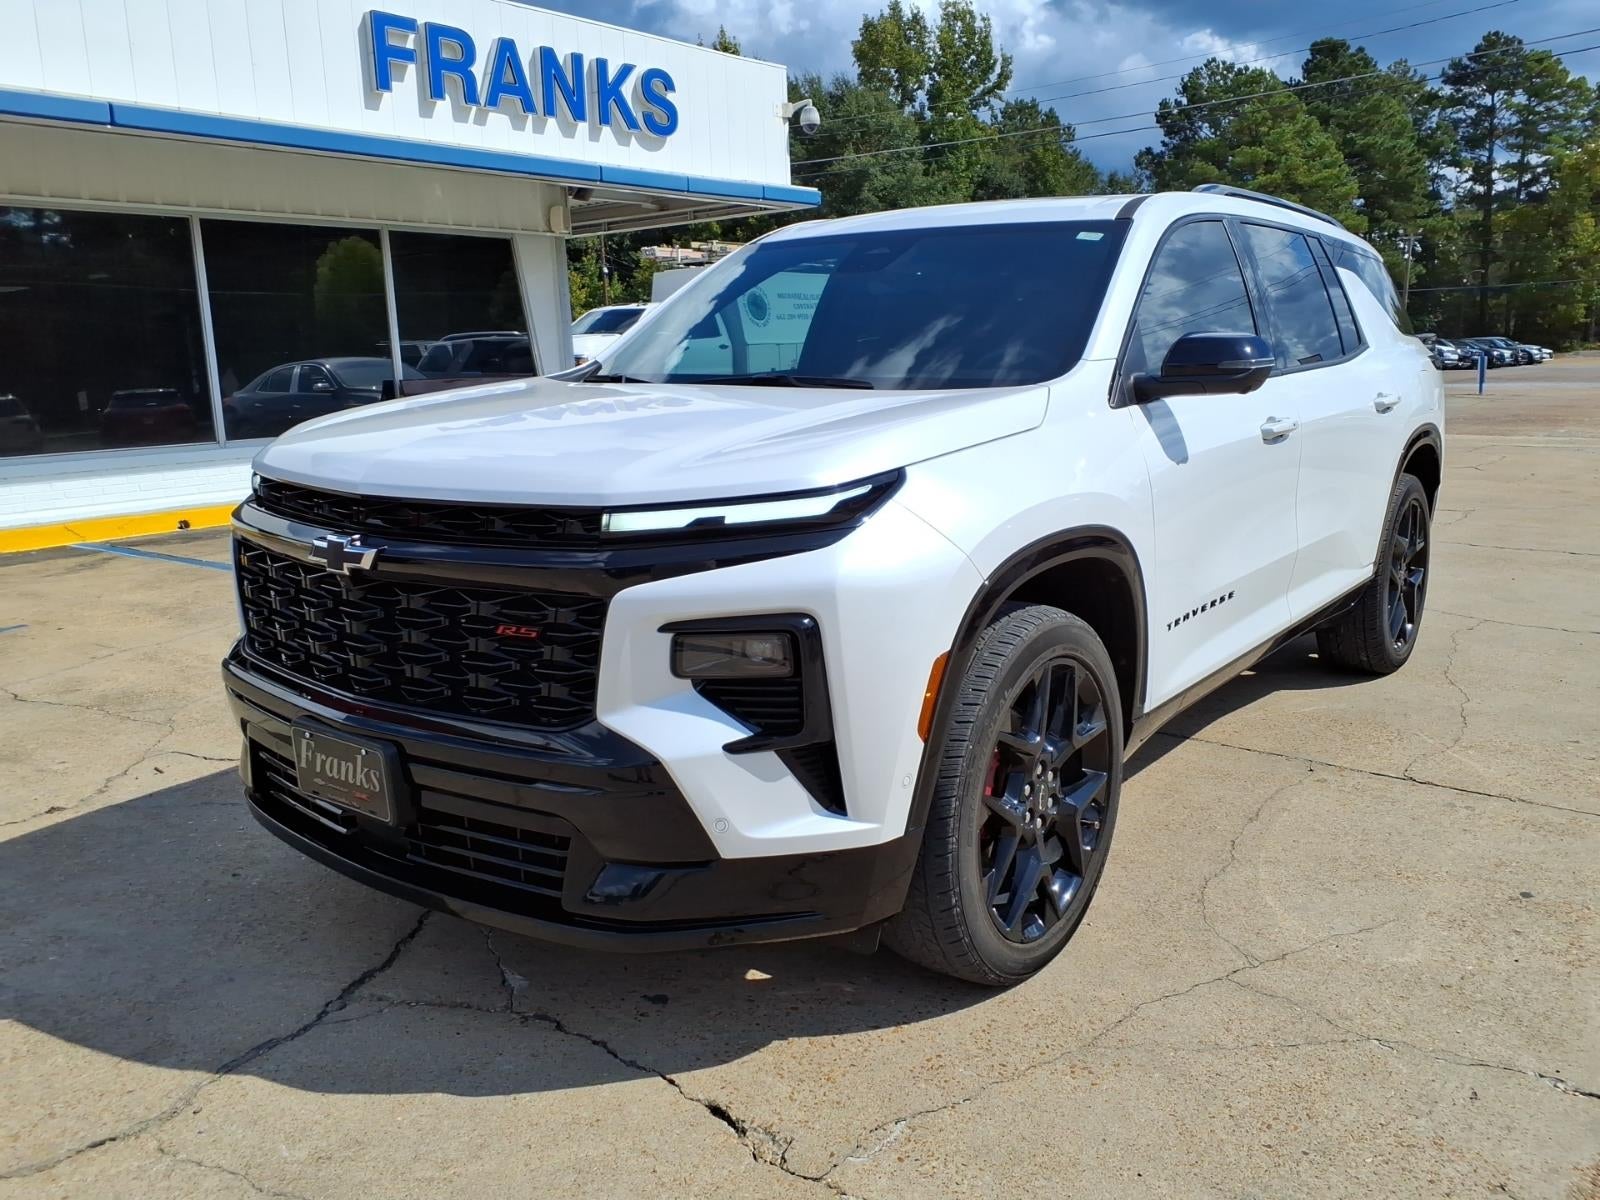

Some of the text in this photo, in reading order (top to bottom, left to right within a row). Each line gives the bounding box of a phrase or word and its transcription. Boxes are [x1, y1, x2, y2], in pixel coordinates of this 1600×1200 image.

[368, 10, 679, 138] FRANKS
[496, 624, 538, 638] RS
[1166, 590, 1236, 632] TRAVERSE
[300, 739, 380, 792] Franks
